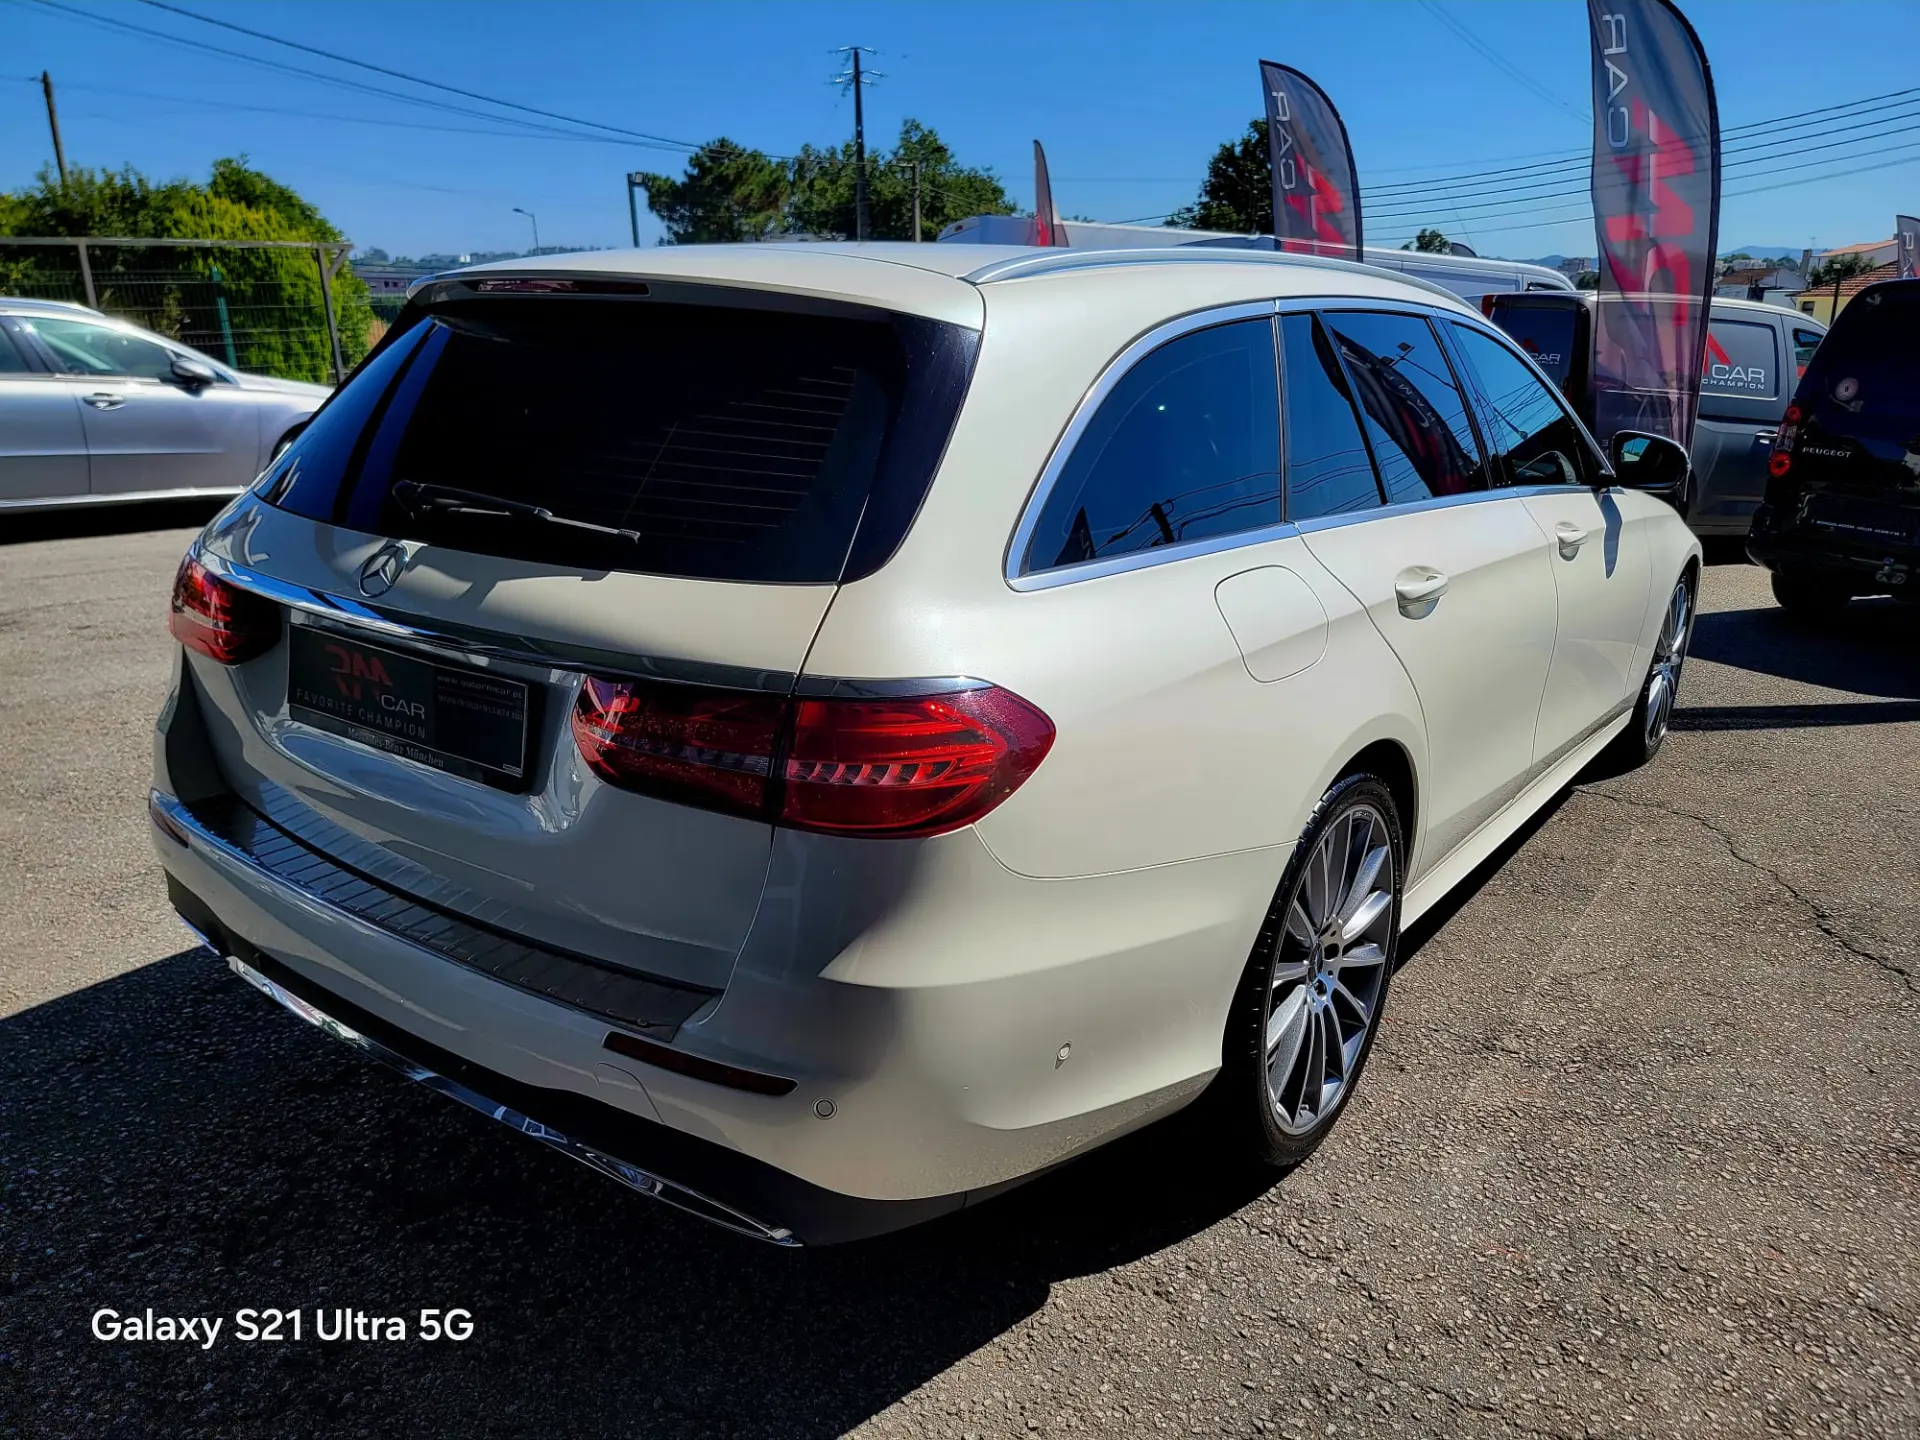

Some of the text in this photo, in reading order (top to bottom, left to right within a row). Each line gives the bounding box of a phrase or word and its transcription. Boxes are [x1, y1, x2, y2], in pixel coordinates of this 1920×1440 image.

[1528, 352, 1561, 362] CAR
[1711, 364, 1765, 383] CAR
[1701, 378, 1765, 390] CHAMPION
[1801, 446, 1852, 458] PEUGEOT
[296, 688, 427, 739] FAVORITE CHAMPION
[380, 694, 427, 721] CAR
